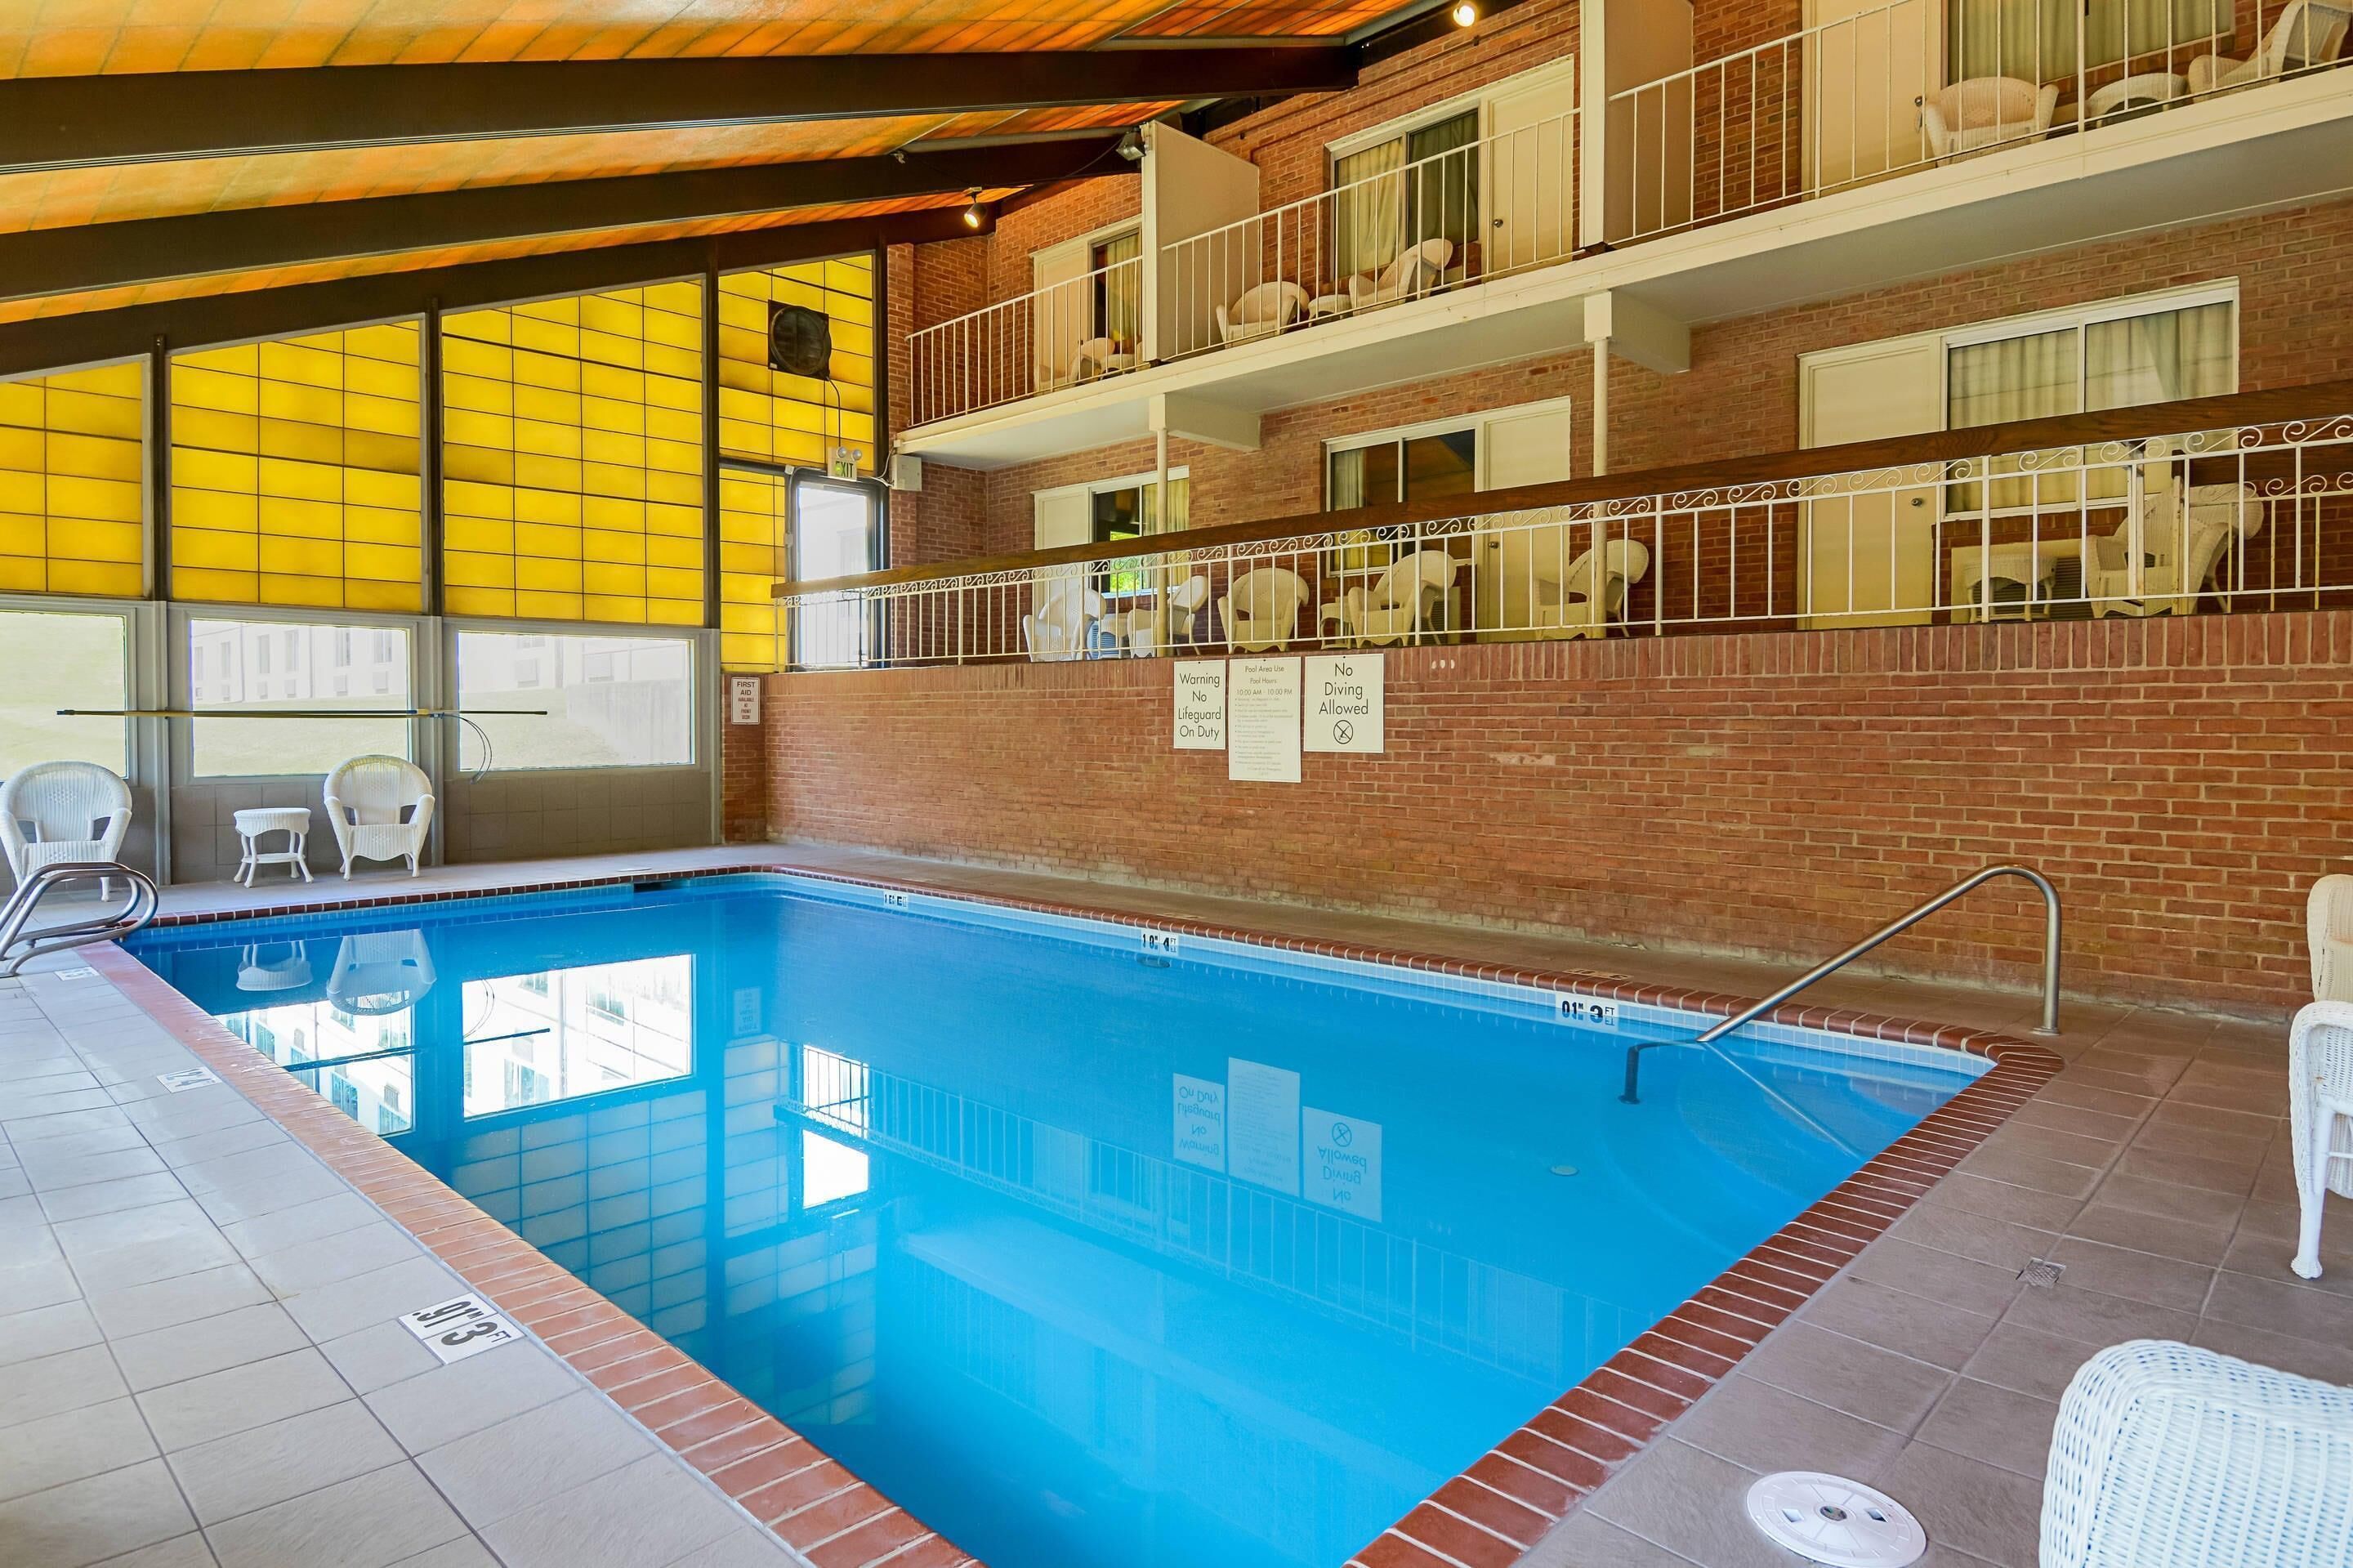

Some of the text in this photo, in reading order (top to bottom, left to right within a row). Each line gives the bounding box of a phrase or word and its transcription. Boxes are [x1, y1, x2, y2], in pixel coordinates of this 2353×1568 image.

[835, 461, 854, 478] EXIT
[1245, 664, 1257, 672] Pool
[1334, 663, 1353, 677] No
[1179, 672, 1221, 688] Warning
[1192, 690, 1207, 702] No
[1324, 681, 1363, 700] Diving
[1178, 706, 1221, 723] Lifeguard
[1319, 699, 1368, 715] Allowed
[1179, 725, 1220, 742] On Duty
